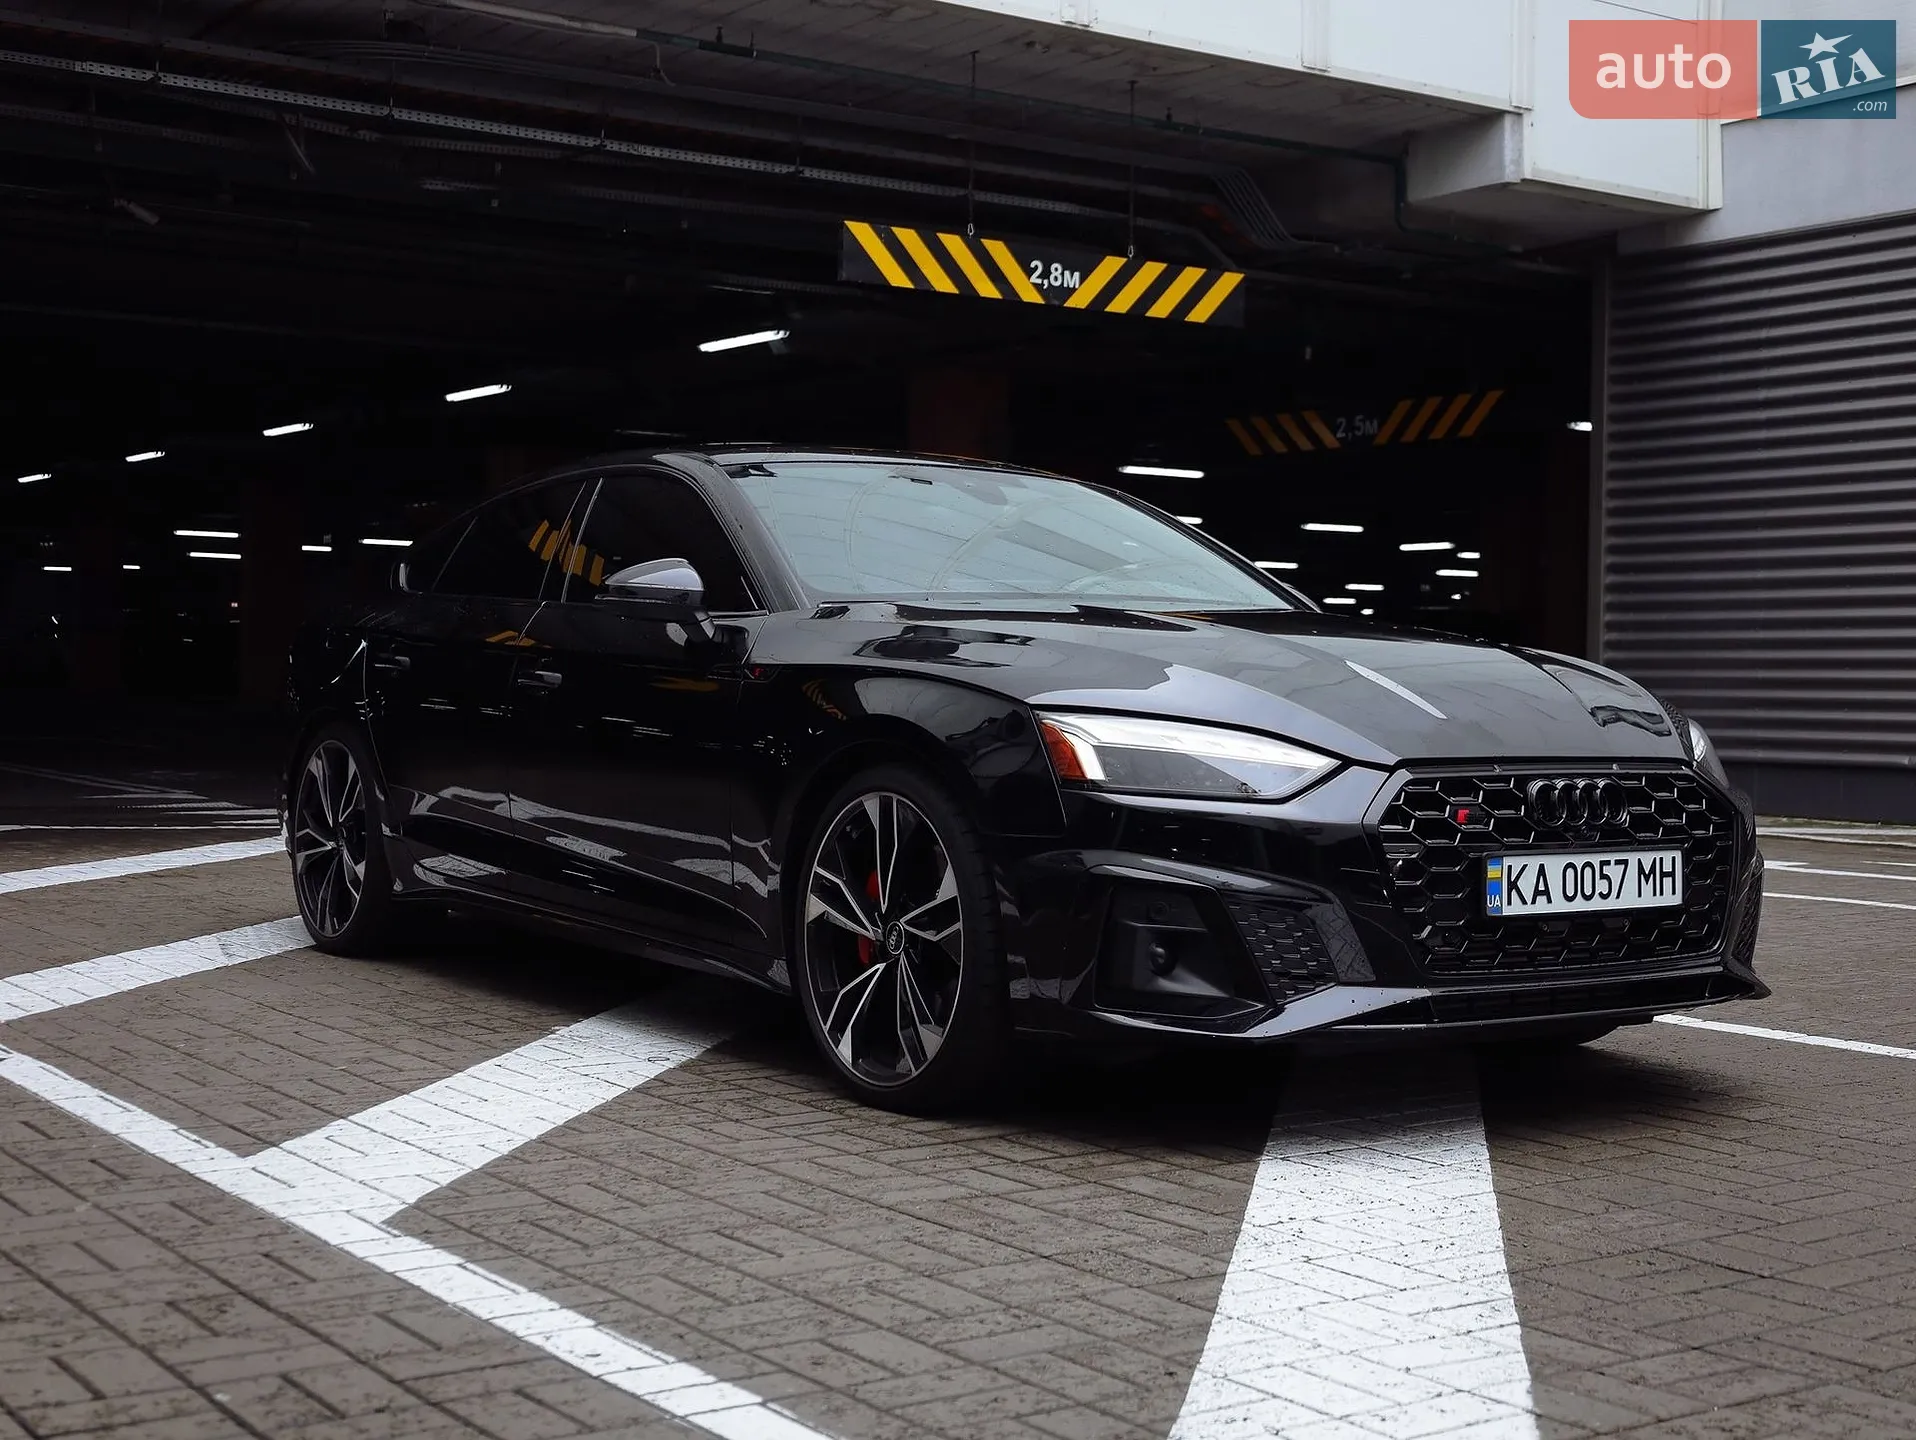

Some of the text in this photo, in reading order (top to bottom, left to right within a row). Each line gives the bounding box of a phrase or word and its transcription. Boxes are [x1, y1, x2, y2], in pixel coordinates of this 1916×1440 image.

[1506, 855, 1676, 906] KA 0057 MH
[1487, 894, 1501, 908] UA
